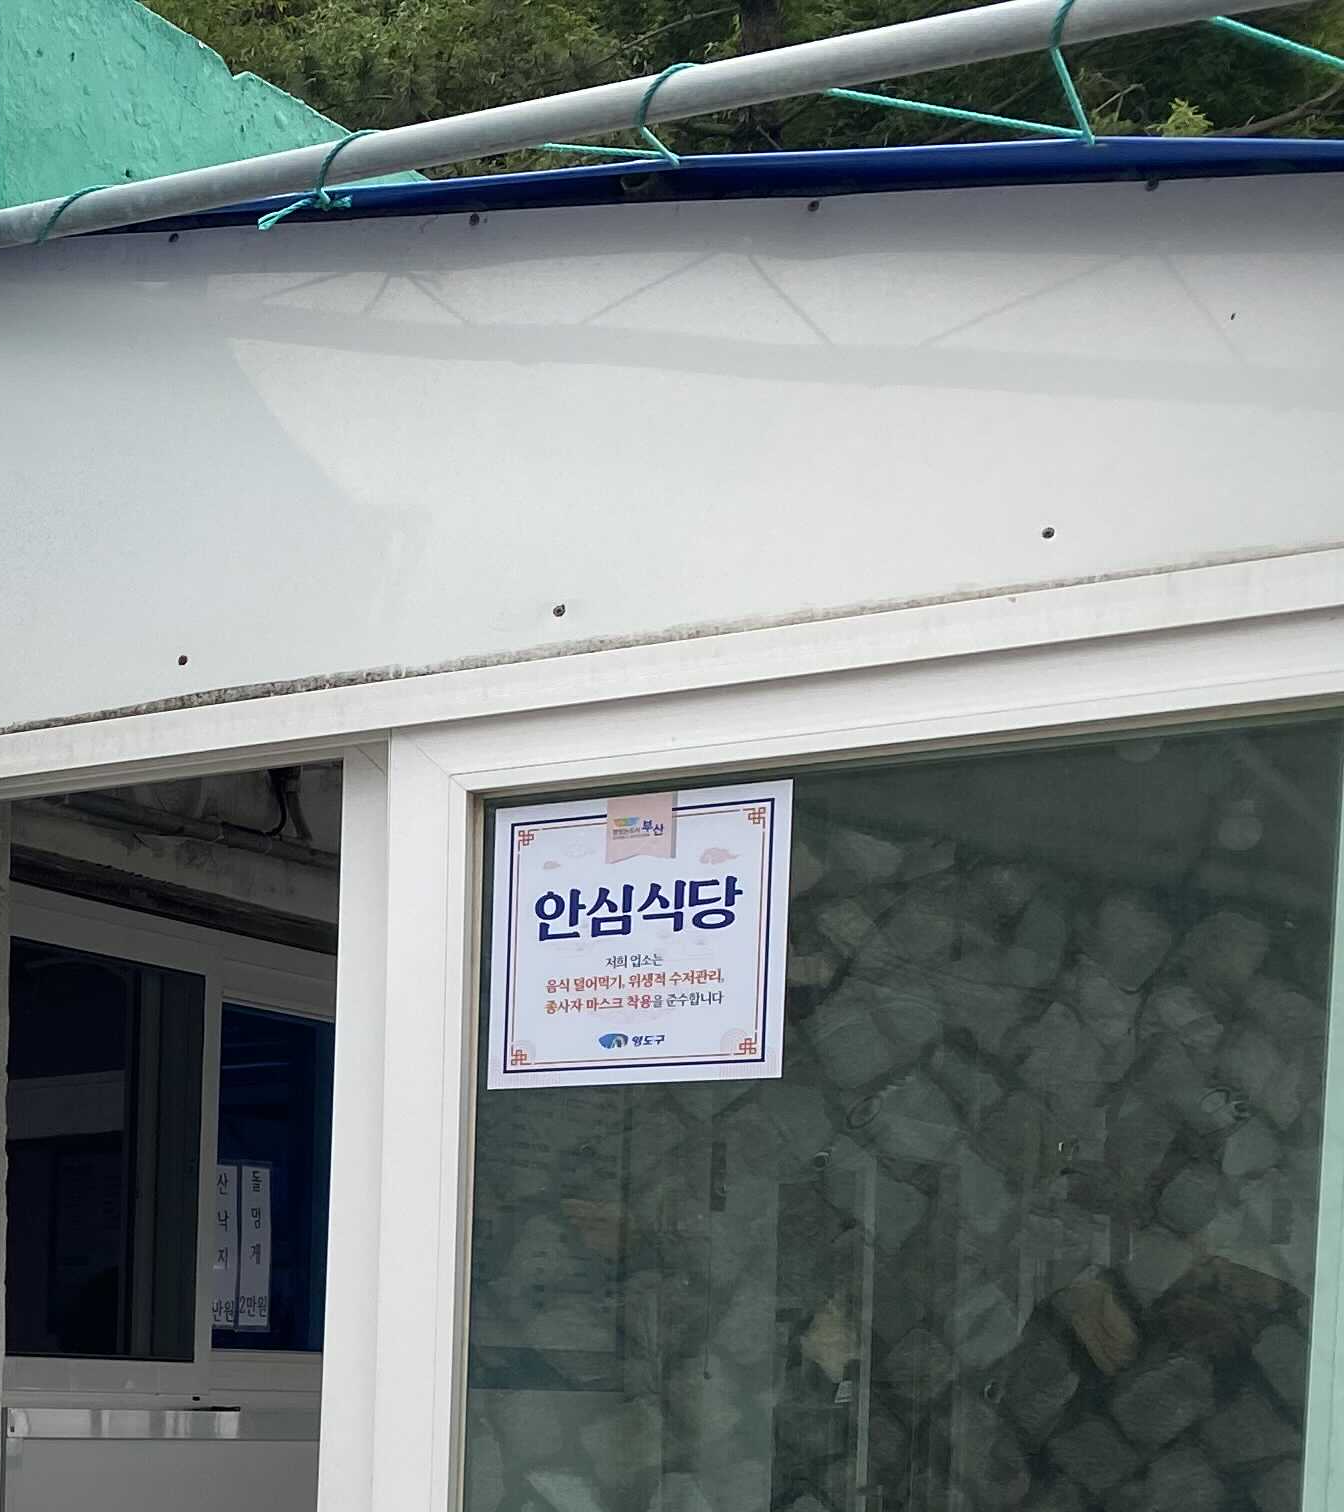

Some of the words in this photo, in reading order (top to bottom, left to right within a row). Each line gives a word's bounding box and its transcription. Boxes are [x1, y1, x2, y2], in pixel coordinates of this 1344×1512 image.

[641, 819, 664, 837] 부산
[534, 875, 743, 941] 안심식당
[606, 955, 628, 969] 저희
[630, 953, 663, 968] 업소는
[545, 978, 570, 993] 음식
[628, 971, 666, 988] 위생적
[544, 998, 583, 1015] 종사자
[586, 997, 624, 1011] 마스크
[627, 994, 663, 1009] 착용을
[631, 1034, 665, 1047] 영도구
[239, 1295, 268, 1319] 2만원
